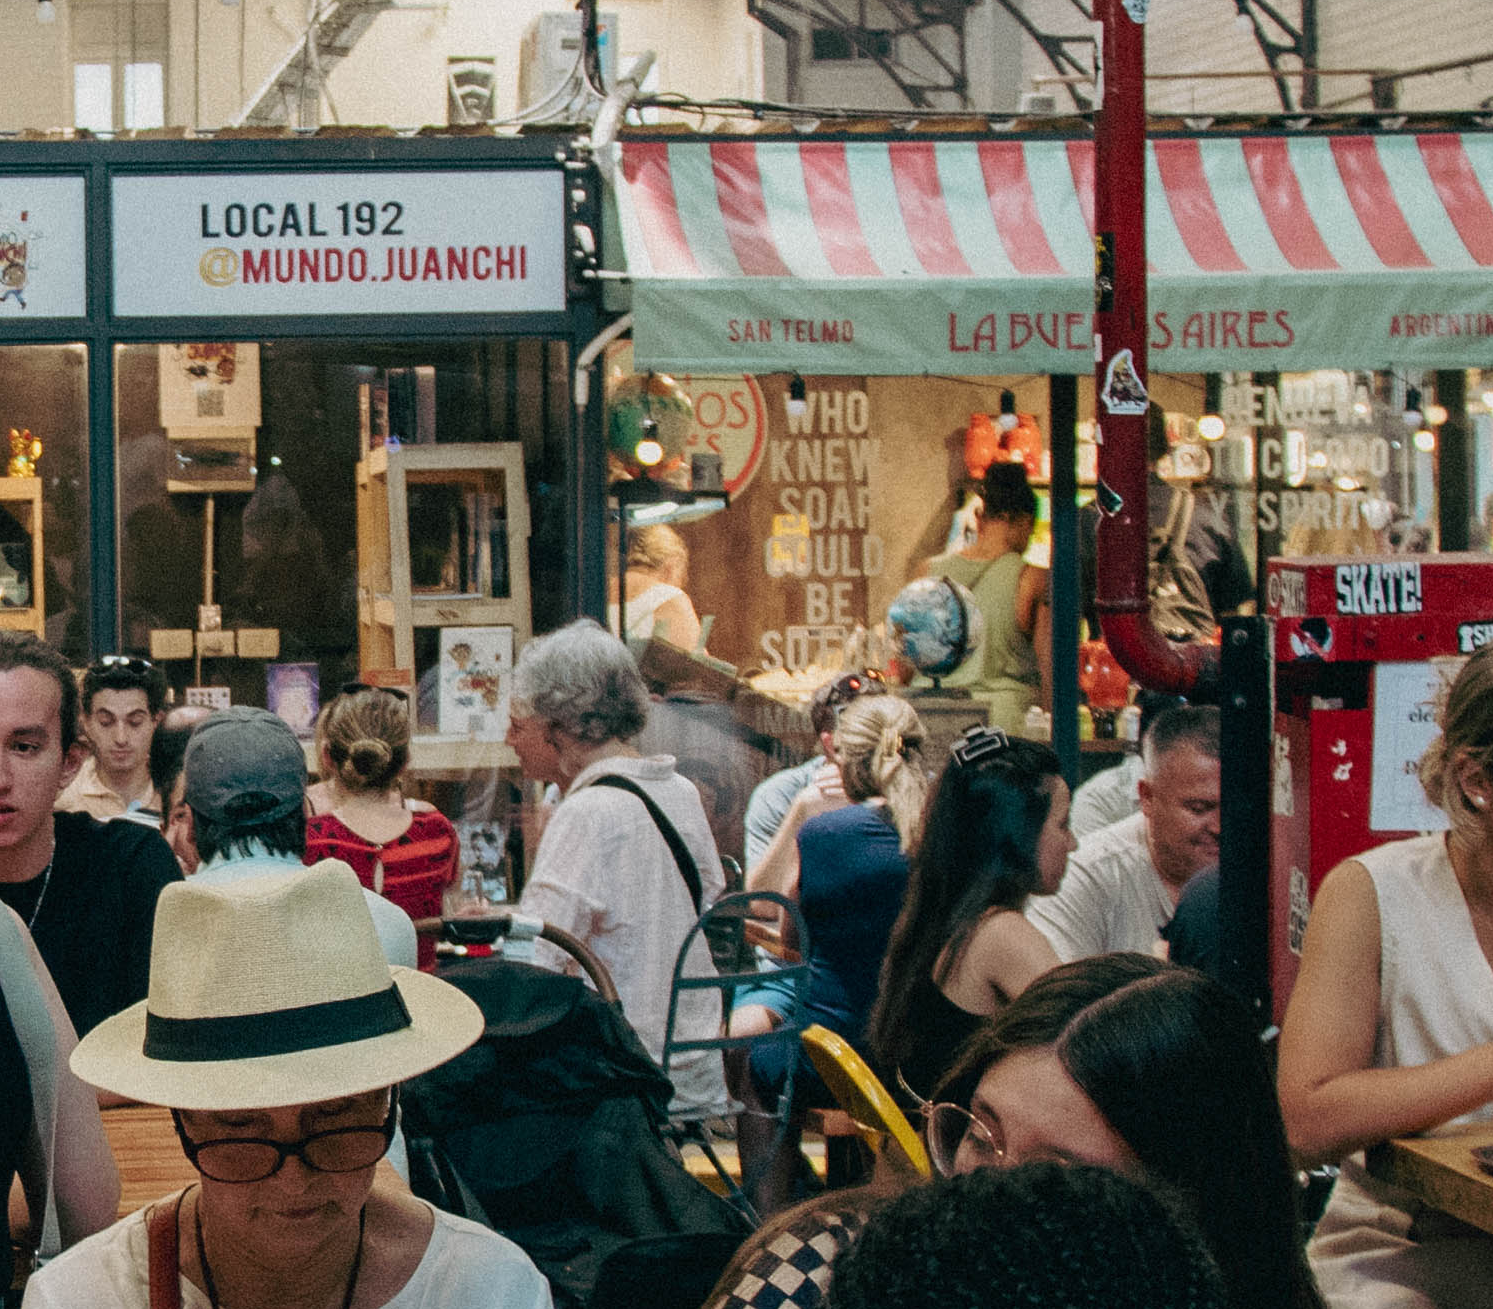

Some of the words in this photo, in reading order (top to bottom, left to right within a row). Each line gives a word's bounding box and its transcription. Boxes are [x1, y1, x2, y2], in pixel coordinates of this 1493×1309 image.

[201, 202, 327, 239] LOCAL
[336, 200, 405, 236] 192
[199, 245, 528, 288] @MUNDO.JUANCHI
[728, 319, 773, 343] SAN
[781, 319, 855, 343] TELMO
[948, 311, 998, 353] LA
[1008, 310, 1174, 352] BUES
[1181, 309, 1296, 349] AIRES
[784, 390, 870, 435] WHO
[770, 438, 881, 483] KNEW
[766, 533, 885, 578] COULD
[806, 582, 855, 626] BE
[1336, 561, 1423, 614] SKATE!
